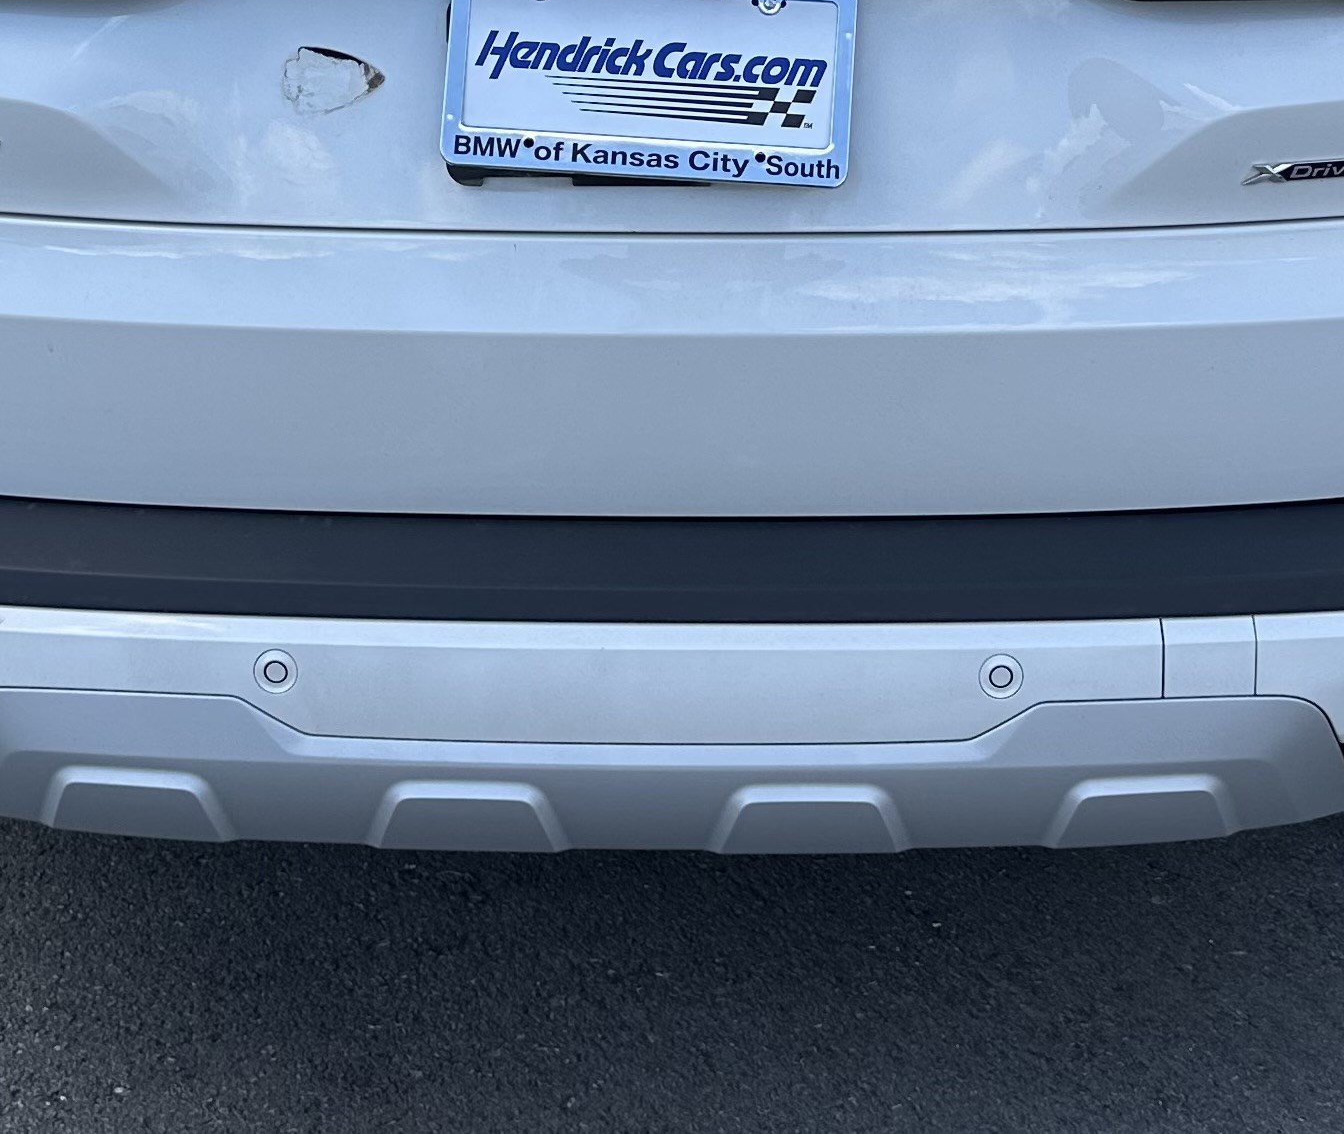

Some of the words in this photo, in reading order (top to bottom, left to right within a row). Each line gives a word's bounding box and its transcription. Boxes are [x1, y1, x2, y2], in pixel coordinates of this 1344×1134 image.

[453, 135, 521, 159] BMW
[534, 142, 566, 161] of
[571, 143, 680, 170] Kansas
[688, 150, 749, 178] City
[765, 155, 841, 180] South
